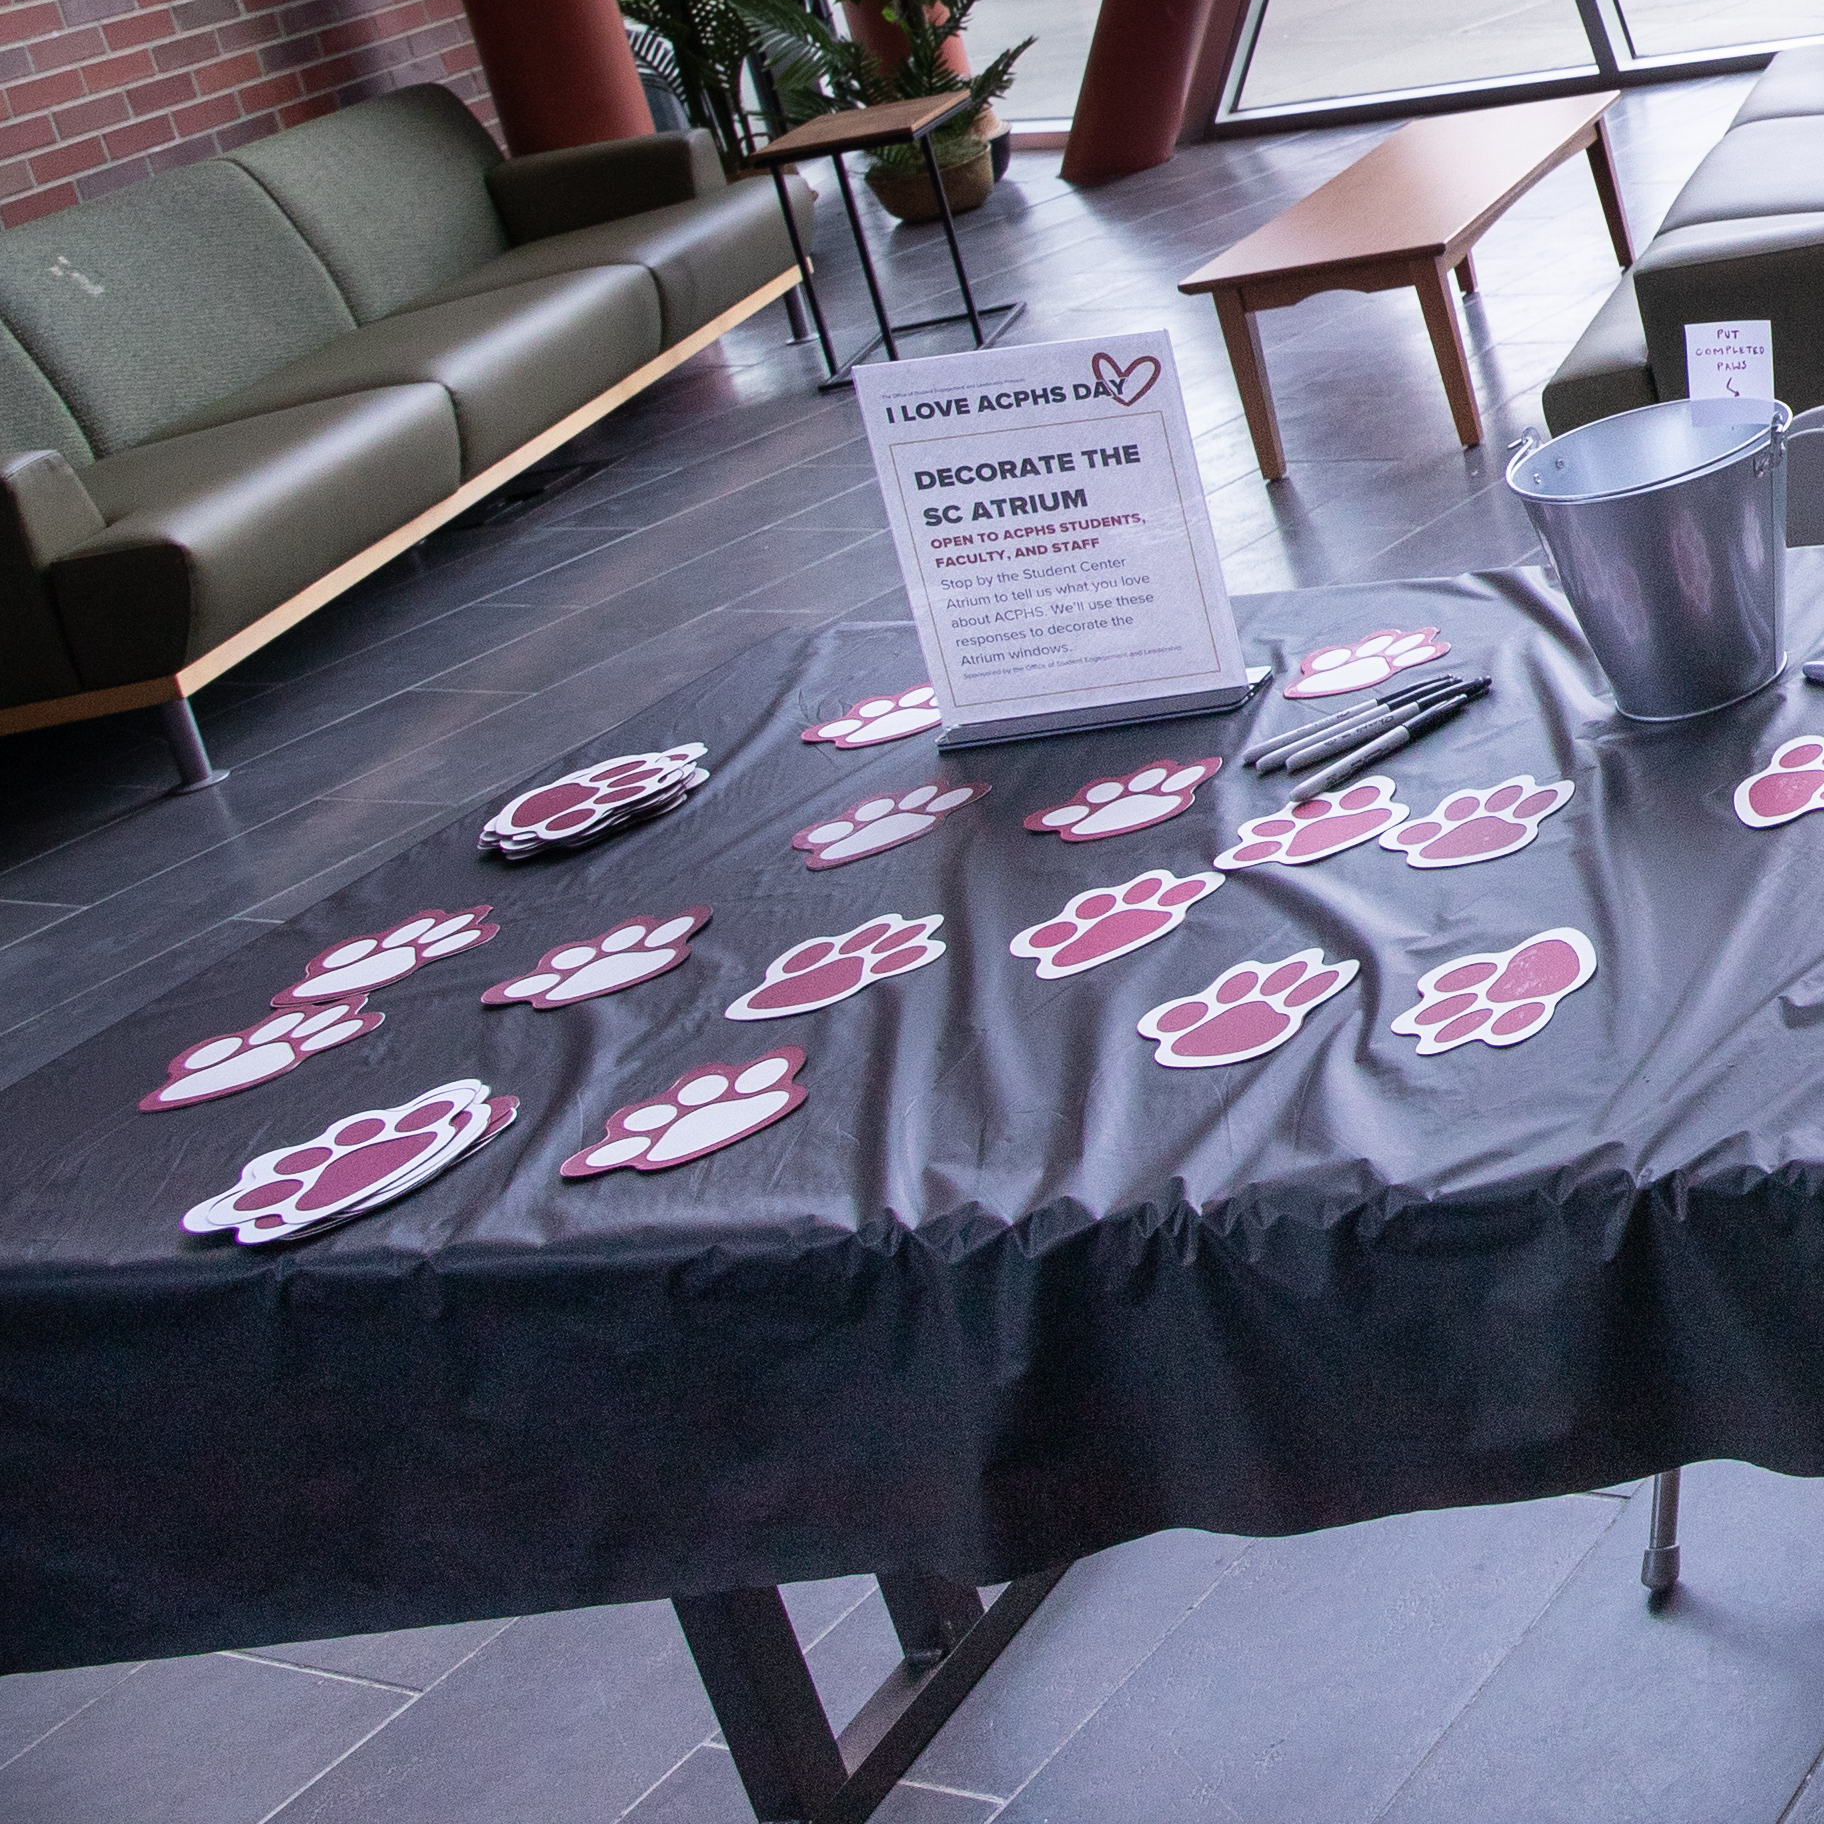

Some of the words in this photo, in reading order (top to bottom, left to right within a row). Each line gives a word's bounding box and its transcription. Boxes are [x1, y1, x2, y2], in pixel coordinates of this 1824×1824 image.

[1695, 345, 1765, 356] COMPLETED
[1717, 328, 1739, 339] PUT
[1717, 360, 1747, 371] PAWS
[885, 406, 896, 424] I
[901, 398, 971, 422] LOVE
[978, 386, 1067, 413] ACPHS
[1072, 378, 1126, 401] DAY
[914, 452, 1076, 490] DECORATE
[1081, 443, 1141, 469] THE
[923, 504, 964, 527] SC
[971, 488, 1089, 522] ATRIUM
[930, 533, 974, 549] OPEN
[977, 531, 999, 544] TO
[1003, 524, 1056, 541] ACPHS
[1060, 513, 1147, 533] STUDENTS,
[935, 549, 1012, 568] FACULTY,
[1014, 544, 1048, 559] AND
[1052, 537, 1100, 553] STAFF
[941, 577, 974, 592] Stop
[976, 574, 994, 588] by
[997, 571, 1020, 583] the
[1022, 562, 1077, 580] Student
[1080, 556, 1127, 573] Center
[946, 594, 991, 610] Atrium
[994, 591, 1009, 603] to
[1012, 587, 1034, 601] tell
[1036, 587, 1053, 598] us
[1055, 580, 1089, 596] what
[1091, 579, 1118, 593] you
[1120, 573, 1151, 587] love
[951, 613, 991, 629] about
[994, 606, 1048, 624] ACPHS.
[1050, 600, 1085, 616] We'll
[1088, 598, 1113, 610] use
[1116, 592, 1155, 607] these
[955, 630, 1027, 648] responses
[1030, 626, 1044, 638] to
[1047, 618, 1109, 636] decorate
[1111, 614, 1134, 627] the
[960, 650, 1006, 667] Atrium
[1008, 642, 1073, 661] windows.
